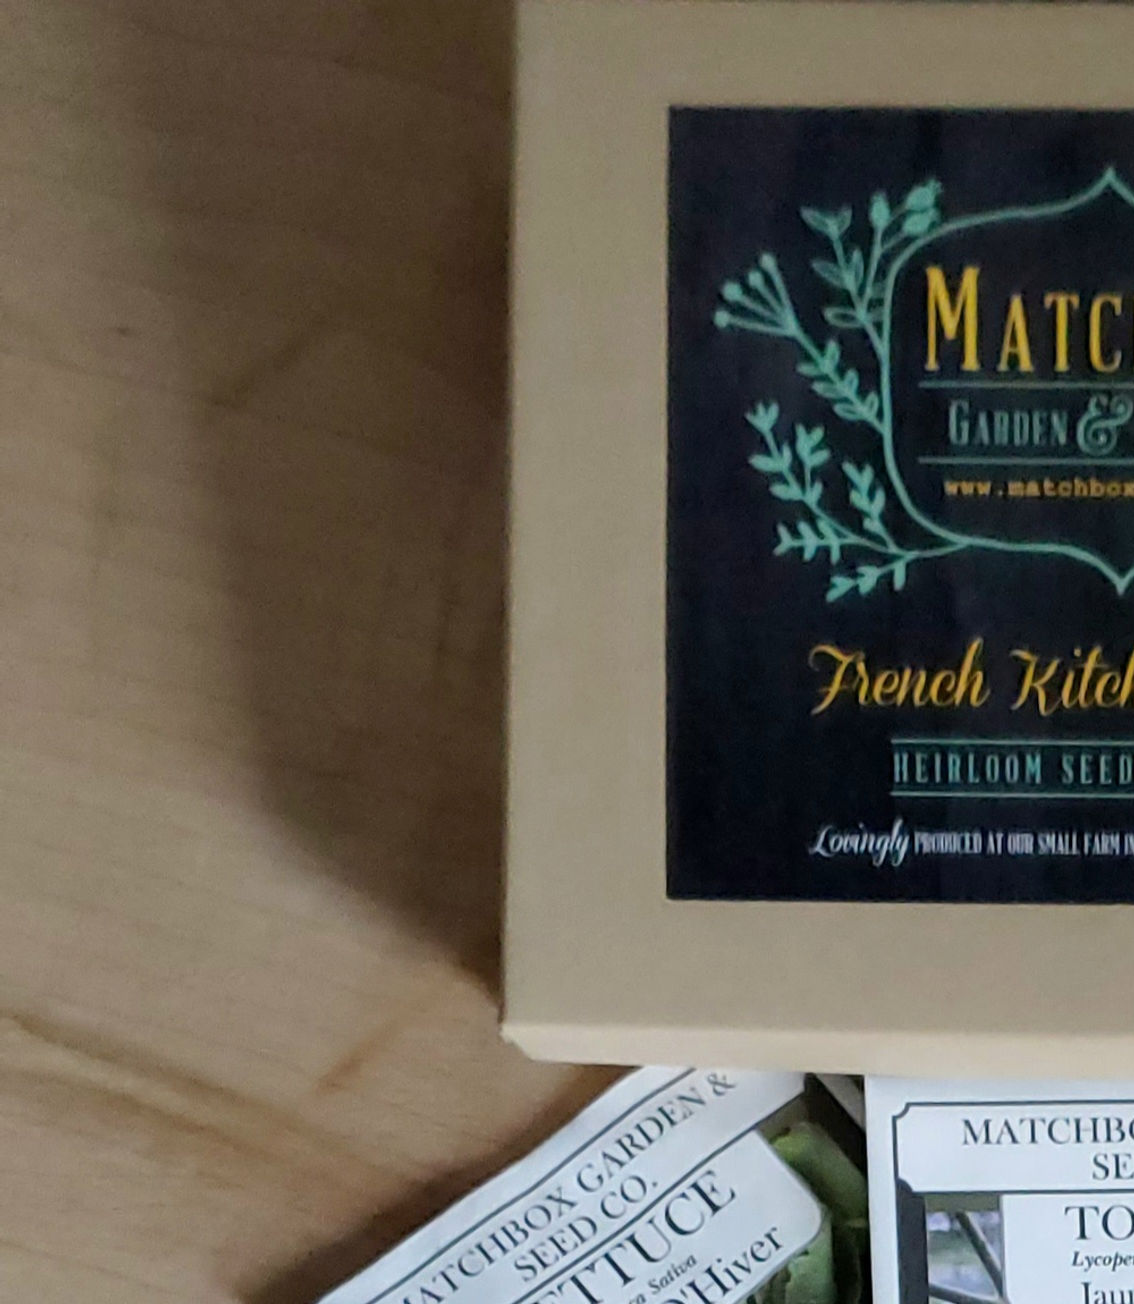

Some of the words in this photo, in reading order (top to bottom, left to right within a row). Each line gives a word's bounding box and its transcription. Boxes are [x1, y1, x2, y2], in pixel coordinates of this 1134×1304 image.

[1076, 393, 1134, 456] &
[809, 637, 991, 717] French
[893, 752, 1044, 785] HEIRLOOM
[1061, 753, 1134, 786] SEED
[809, 818, 910, 867] Lovingly
[914, 831, 982, 854] PRODUCED
[986, 831, 1004, 855] AT
[1007, 831, 1035, 855] OUR
[1037, 831, 1081, 856] SMALL
[1083, 831, 1121, 856] FARM
[576, 1087, 707, 1193] GARDEN
[705, 1070, 738, 1096] &
[513, 1217, 598, 1283] SEED
[600, 1174, 659, 1222] CO.
[647, 1253, 699, 1296] Sativa
